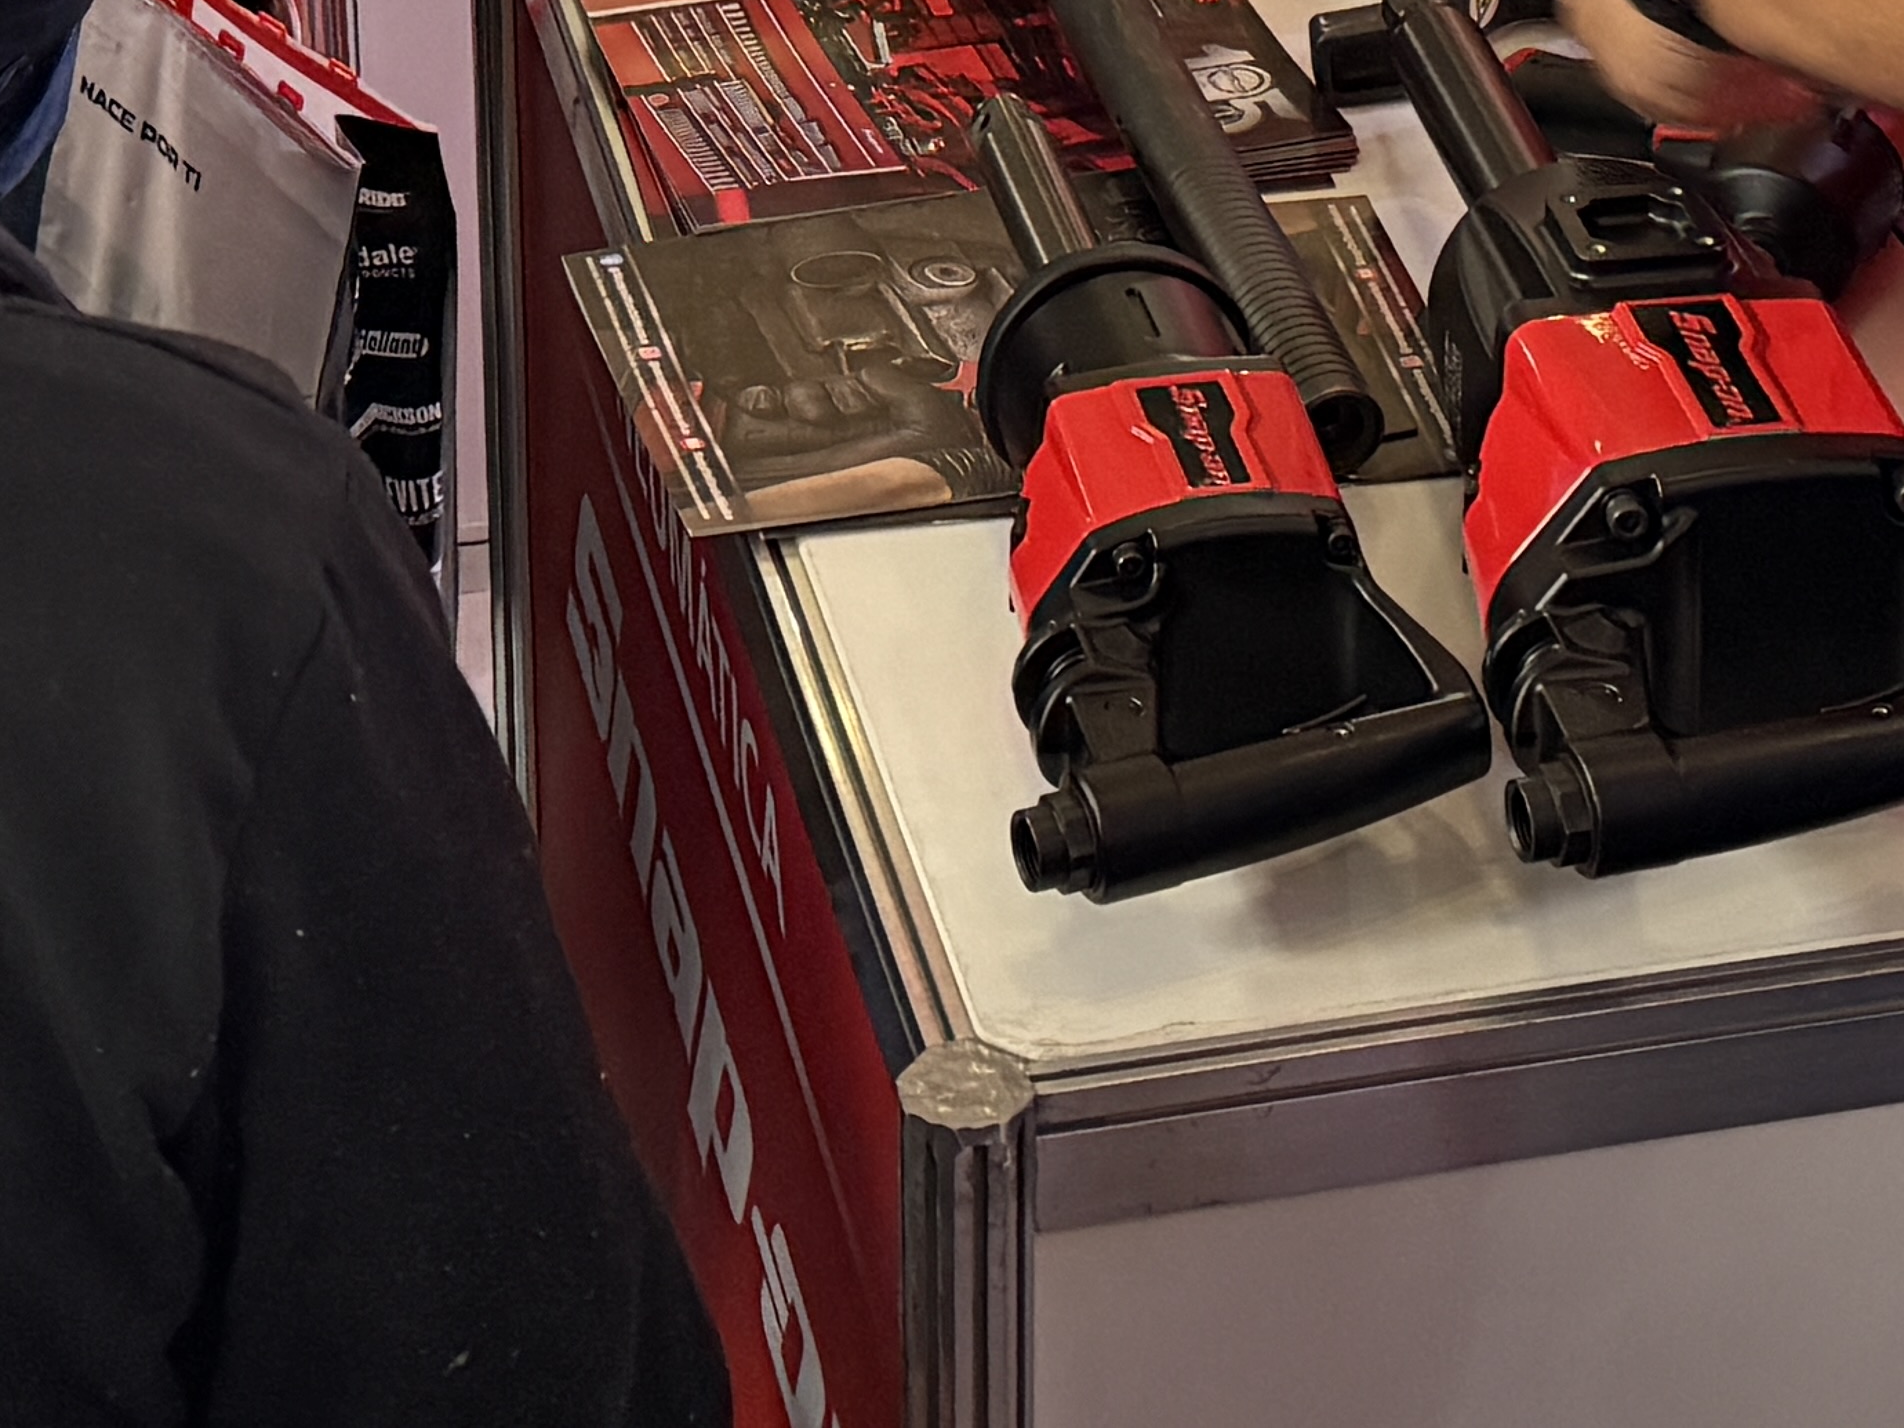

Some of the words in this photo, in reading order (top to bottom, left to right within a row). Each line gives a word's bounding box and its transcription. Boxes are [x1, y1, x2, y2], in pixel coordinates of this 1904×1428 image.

[182, 160, 202, 192] TI
[1669, 309, 1754, 424] Snap-on
[566, 492, 844, 1428] Snap-o
